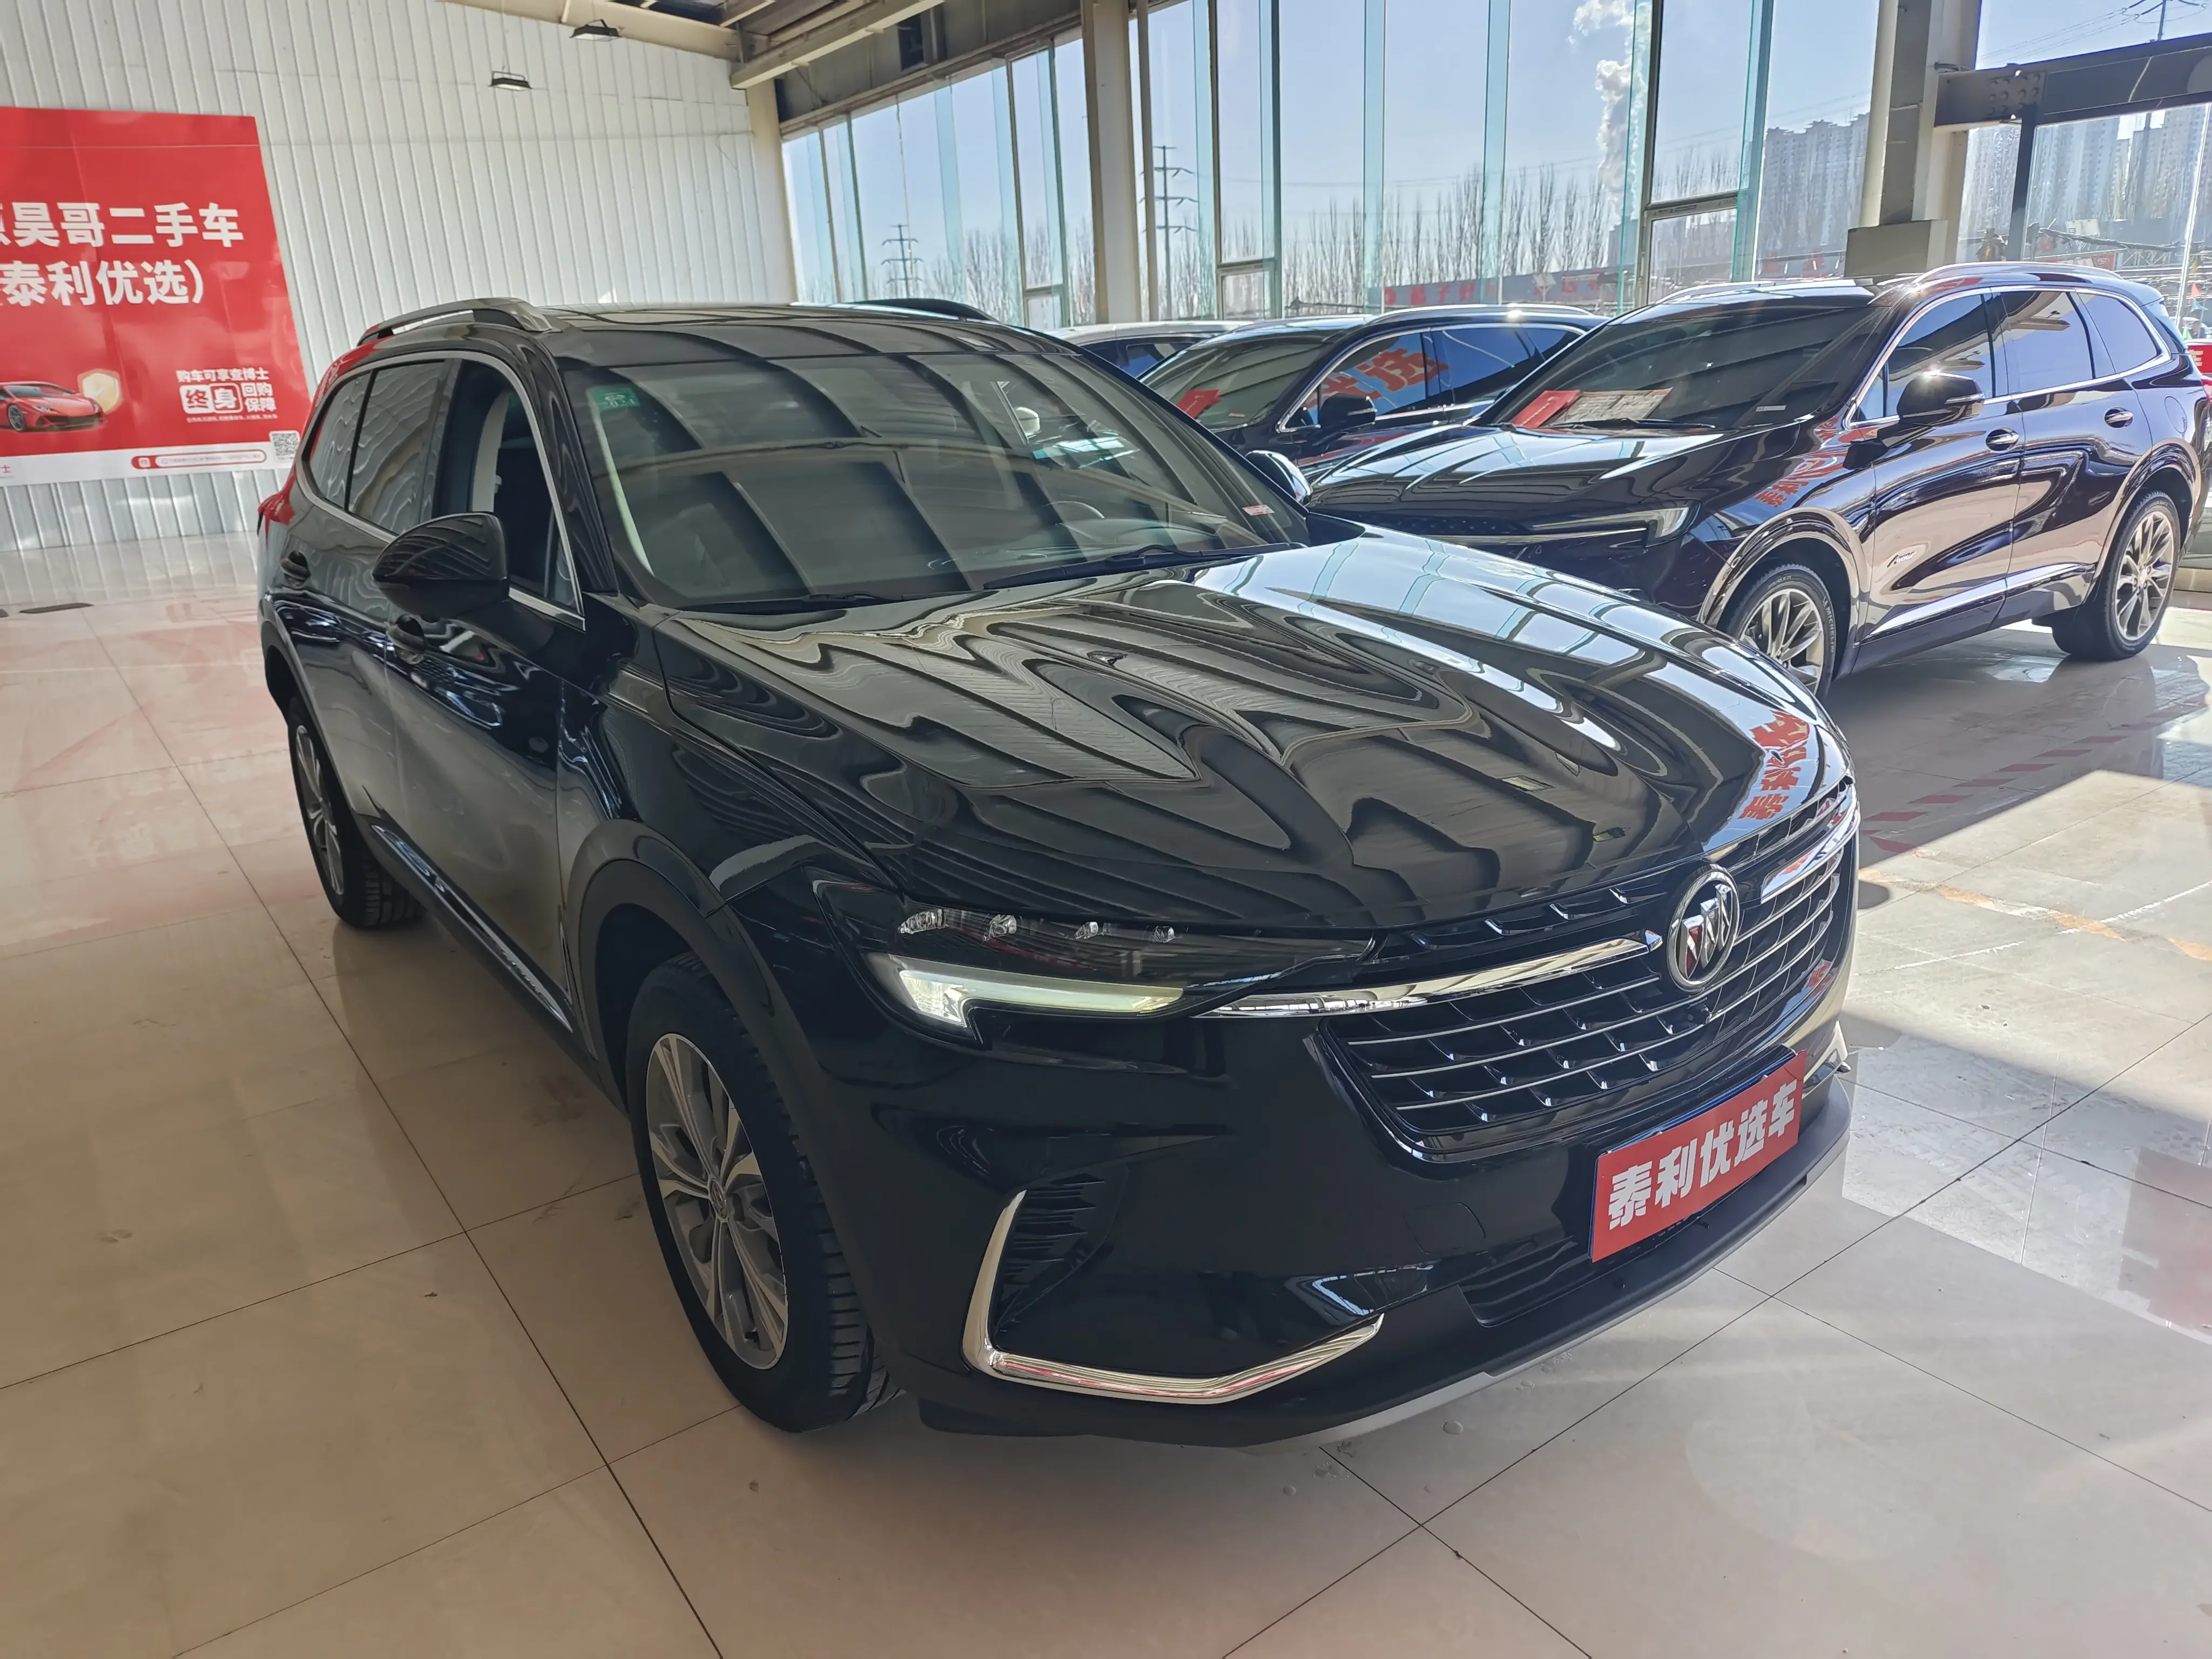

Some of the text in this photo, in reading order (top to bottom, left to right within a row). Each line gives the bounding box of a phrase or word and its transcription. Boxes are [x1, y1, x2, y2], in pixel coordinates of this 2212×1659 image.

[0, 202, 244, 247] 昊哥二手车
[1608, 1079, 1797, 1231] 泰利优选车
